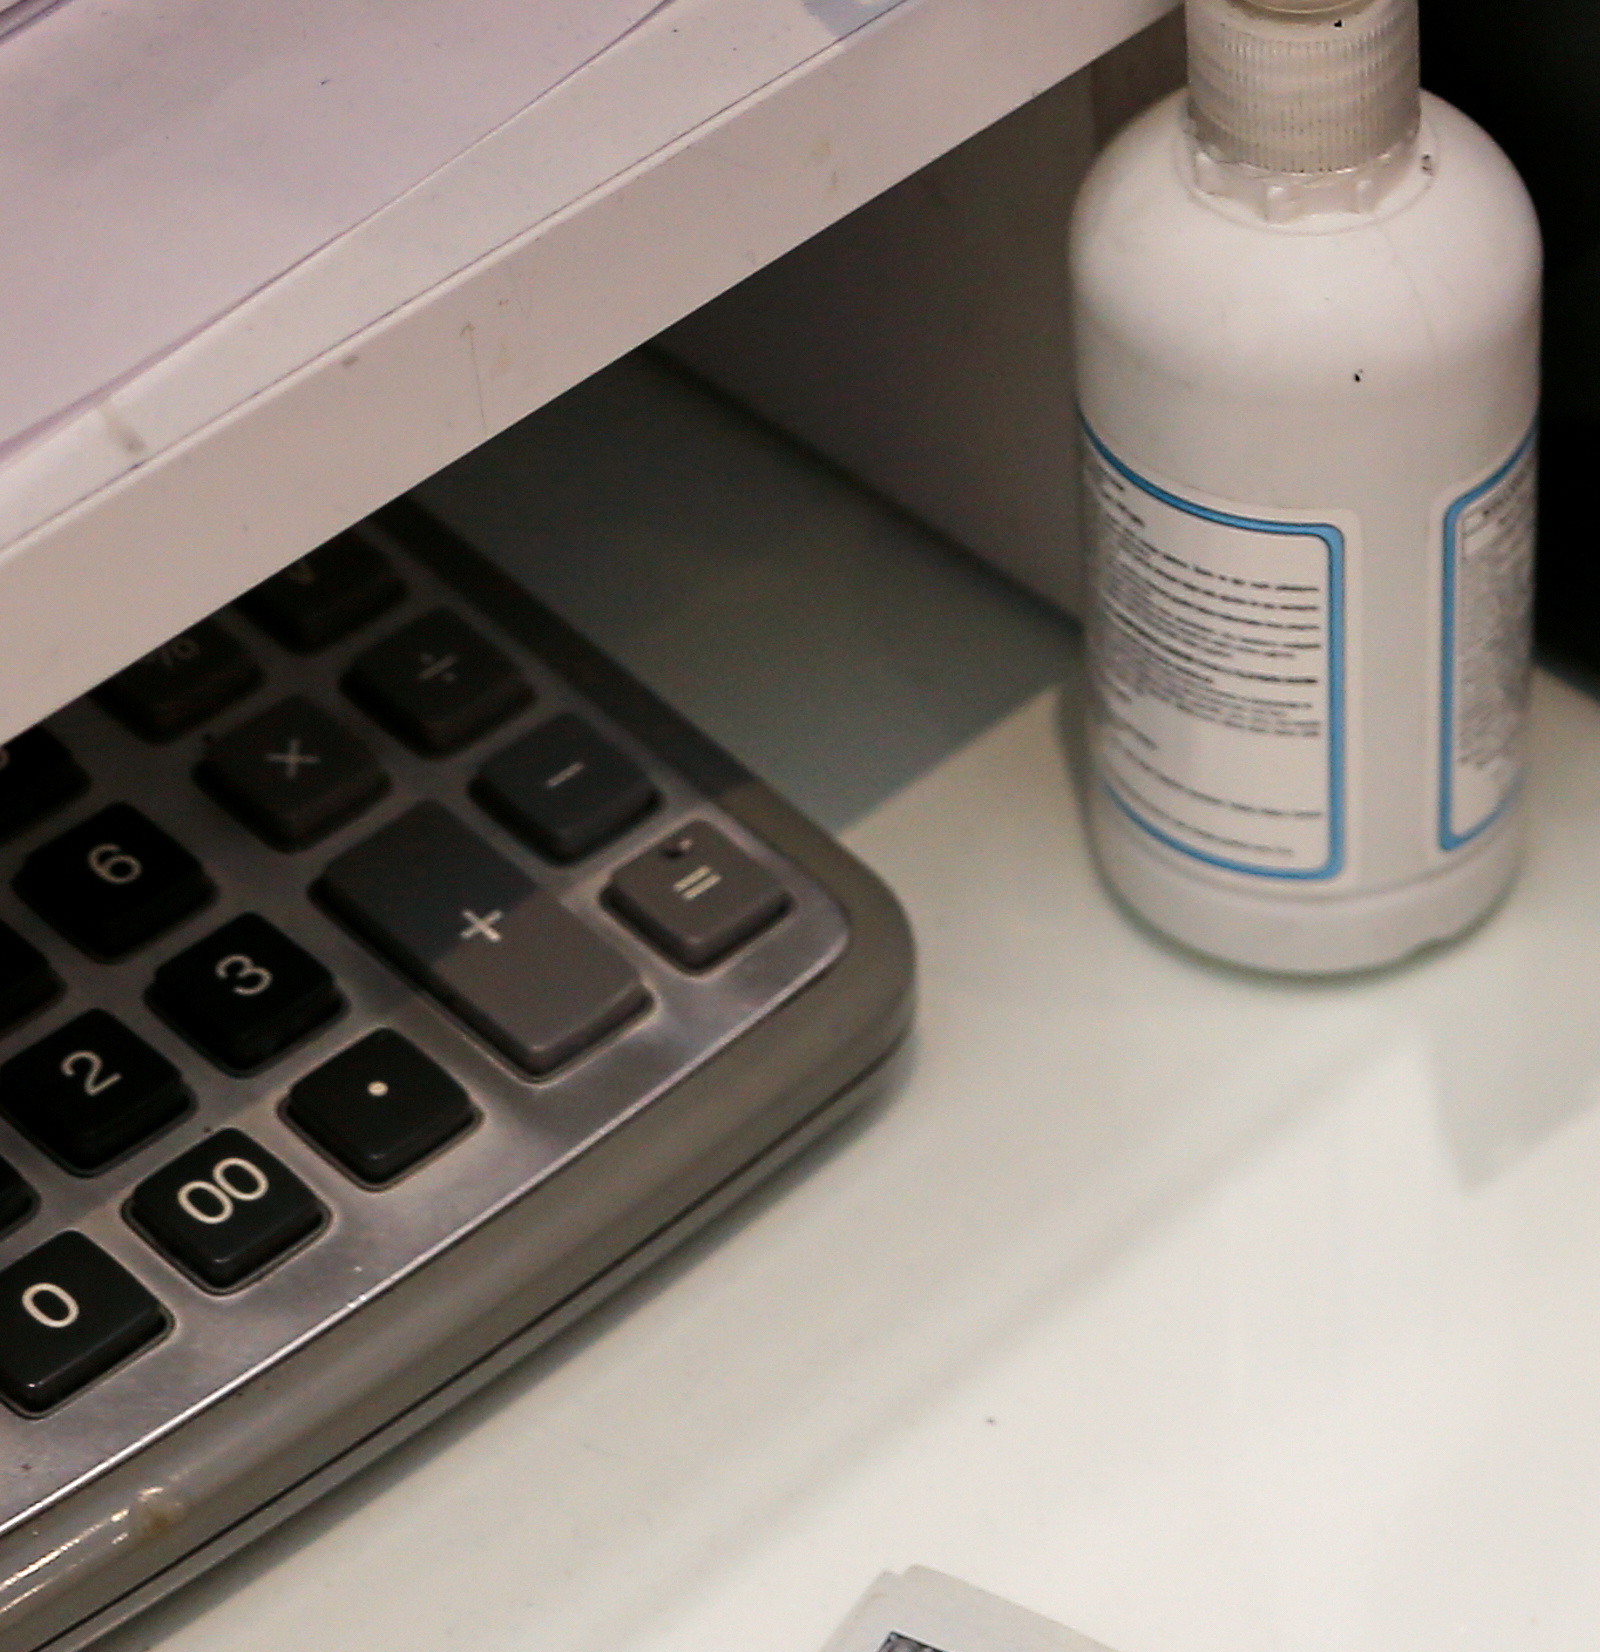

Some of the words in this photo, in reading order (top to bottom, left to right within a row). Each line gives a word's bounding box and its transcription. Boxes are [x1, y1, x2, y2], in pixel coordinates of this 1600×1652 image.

[86, 842, 143, 884] 6
[214, 954, 273, 997] 3
[60, 1048, 122, 1099] 2
[176, 1155, 271, 1226] 00
[20, 1282, 81, 1330] 0
